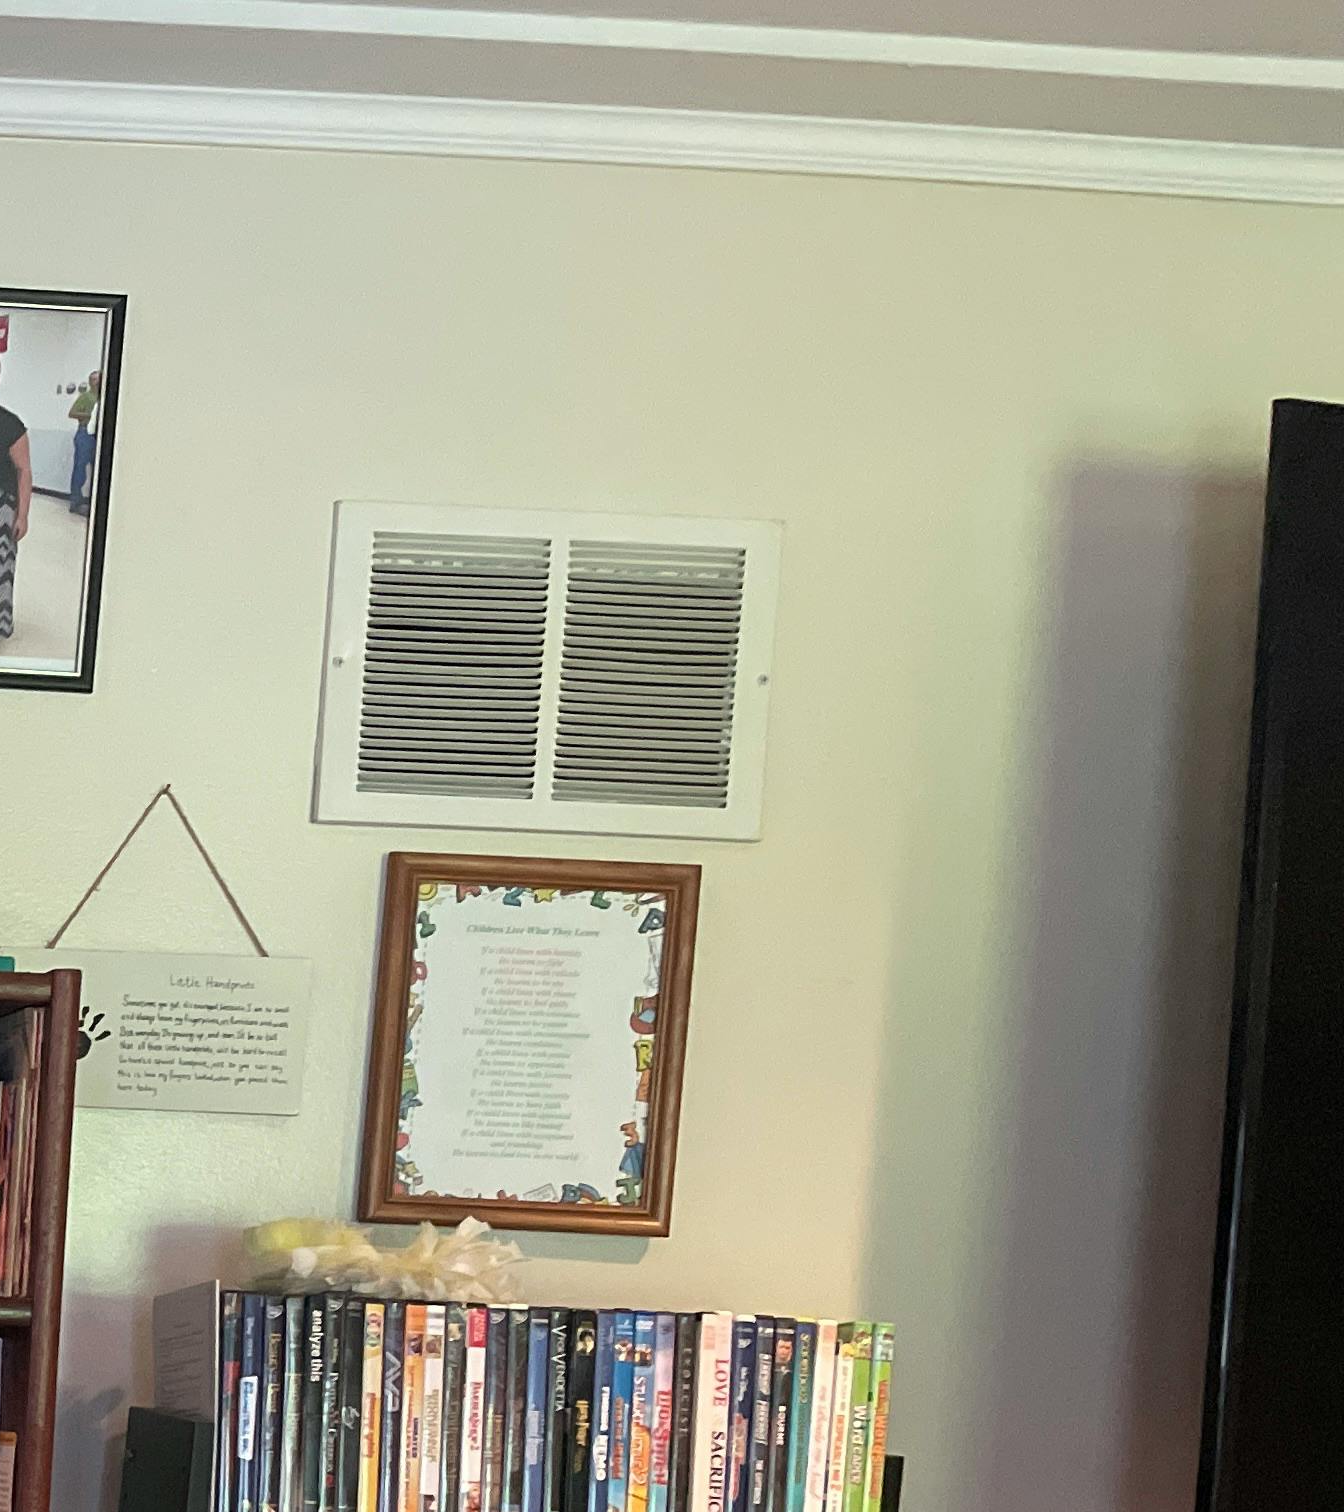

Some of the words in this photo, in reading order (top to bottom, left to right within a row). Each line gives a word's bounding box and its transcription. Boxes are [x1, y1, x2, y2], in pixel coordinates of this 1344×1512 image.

[308, 1310, 324, 1357] analyze
[310, 1358, 323, 1382] this
[551, 1354, 567, 1413] VENDETTA
[713, 1359, 730, 1406] LOVE
[775, 1405, 787, 1446] BOURNE
[595, 1434, 609, 1481] NEMO
